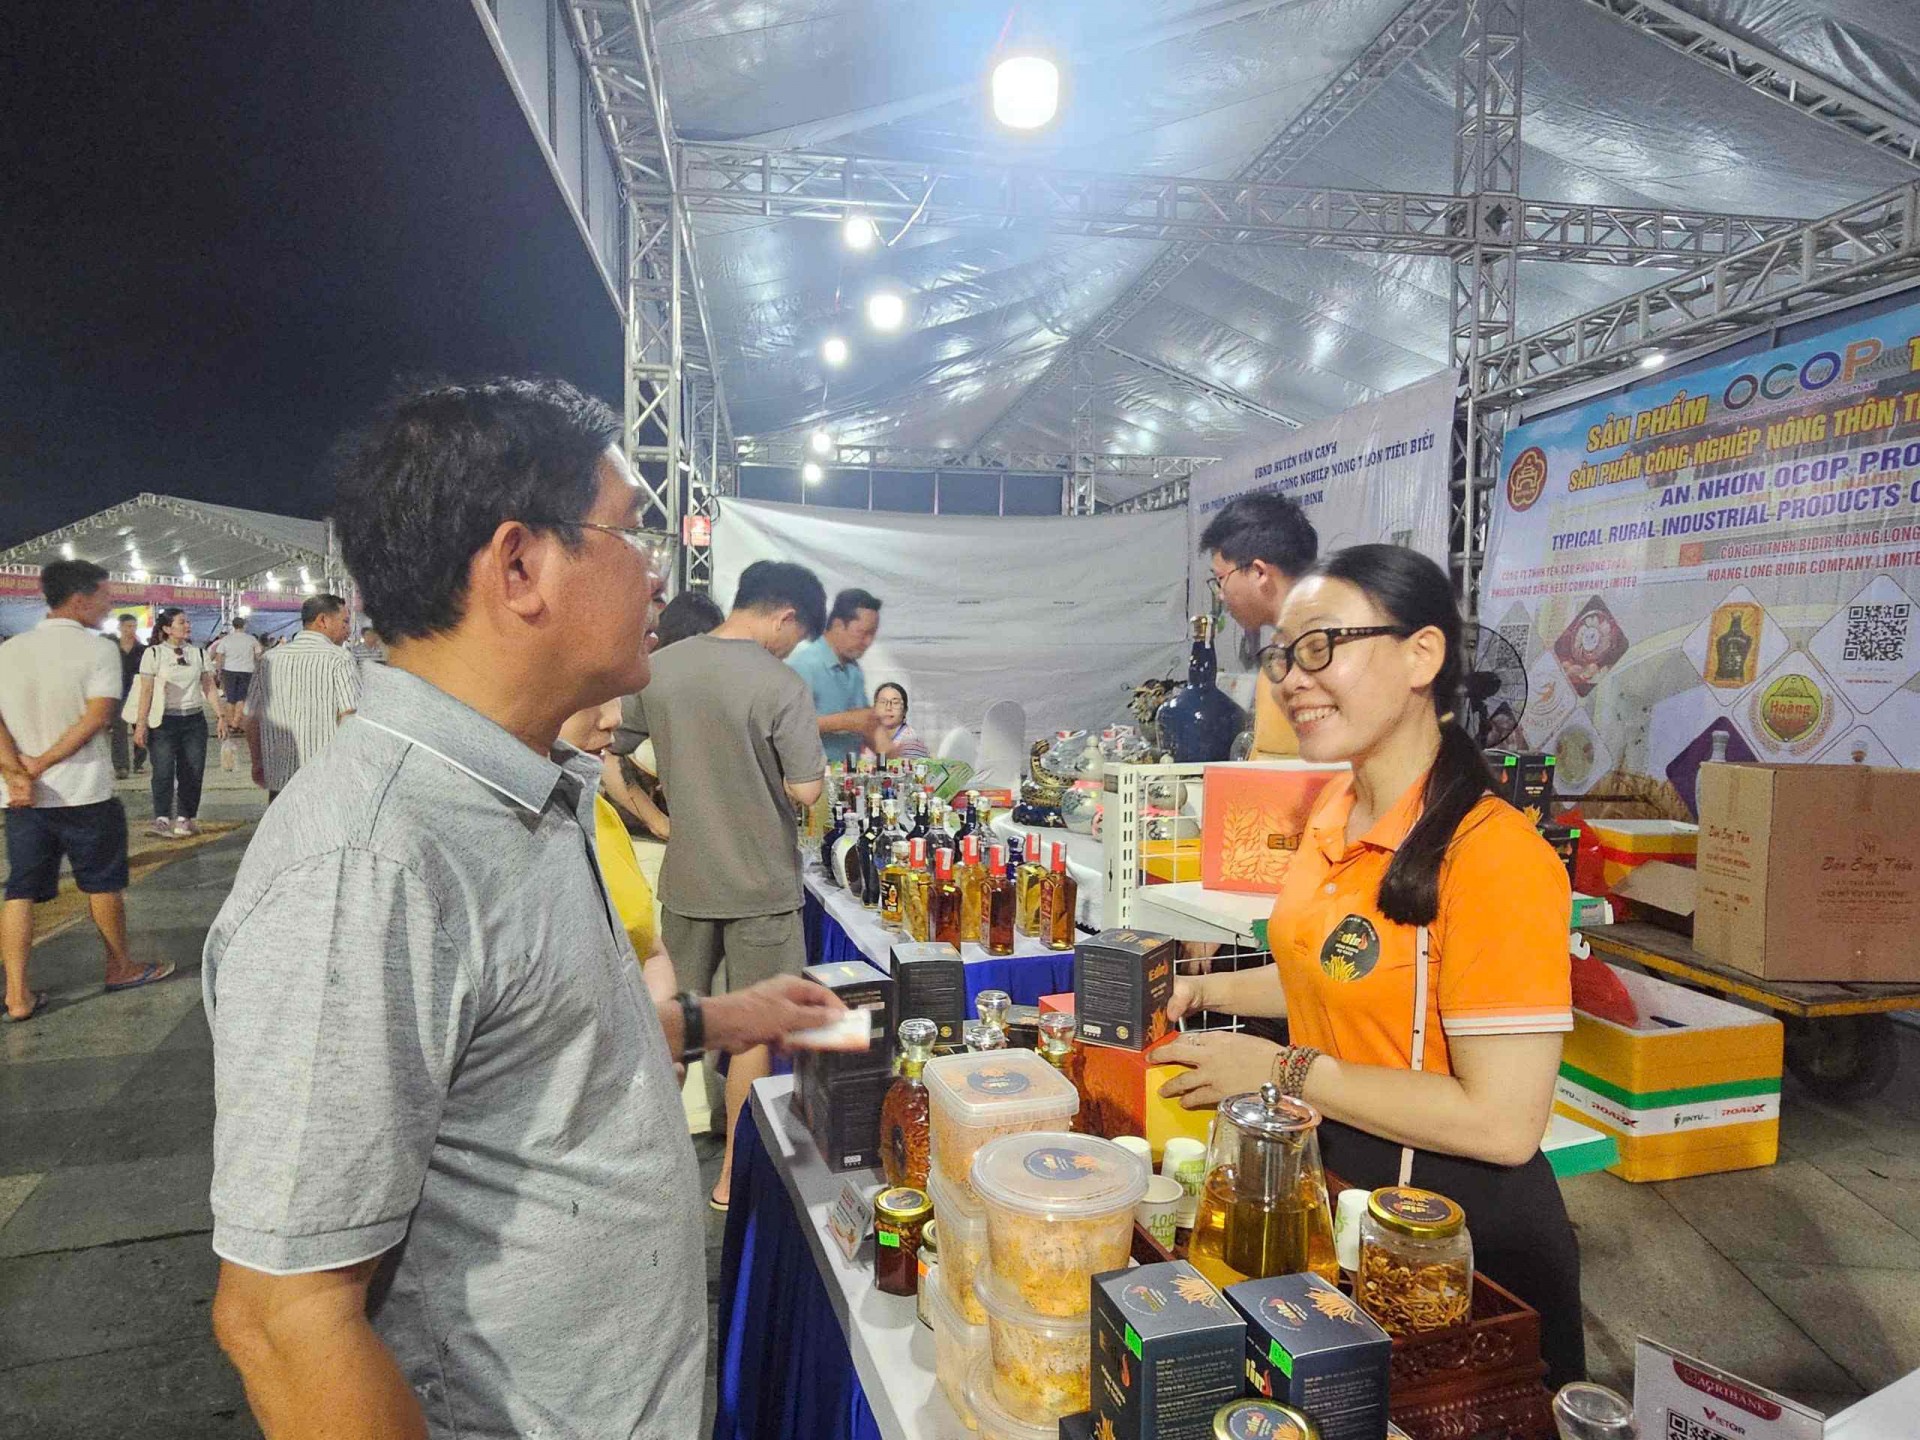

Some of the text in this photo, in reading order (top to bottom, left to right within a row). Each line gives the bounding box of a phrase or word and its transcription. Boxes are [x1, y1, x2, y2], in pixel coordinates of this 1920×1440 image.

[1587, 411, 1632, 453] SẢN
[1635, 389, 1710, 441] PHẨM
[1723, 337, 1883, 411] OCOP
[1568, 460, 1598, 492] SẢN
[1598, 451, 1641, 485] PHẨM
[1645, 446, 1689, 476] CÔNG
[1693, 426, 1761, 466] NGHIỆP
[1767, 414, 1826, 450] NÔNG
[1833, 397, 1896, 438] THÔN
[1659, 485, 1691, 508] AN
[1698, 470, 1766, 502] NHƠN
[1774, 457, 1849, 488] OCOP
[1552, 527, 1602, 551] TYPICAL
[1609, 520, 1655, 544] RURAL
[1662, 503, 1769, 537] INDUSTRIAL
[1777, 483, 1900, 522] PRODUCTS
[1720, 543, 1748, 560] CÔNG
[1800, 536, 1832, 551] BIDIR
[1835, 528, 1879, 548] HOÀNG
[1884, 525, 1920, 542] LONG
[1706, 566, 1741, 582] HOANG
[1744, 564, 1772, 579] LONG
[1775, 560, 1806, 576] BIDIR
[1810, 555, 1872, 574] COMPANY
[1770, 699, 1812, 718] Hoàng
[1698, 1376, 1767, 1414] AGRIBANK
